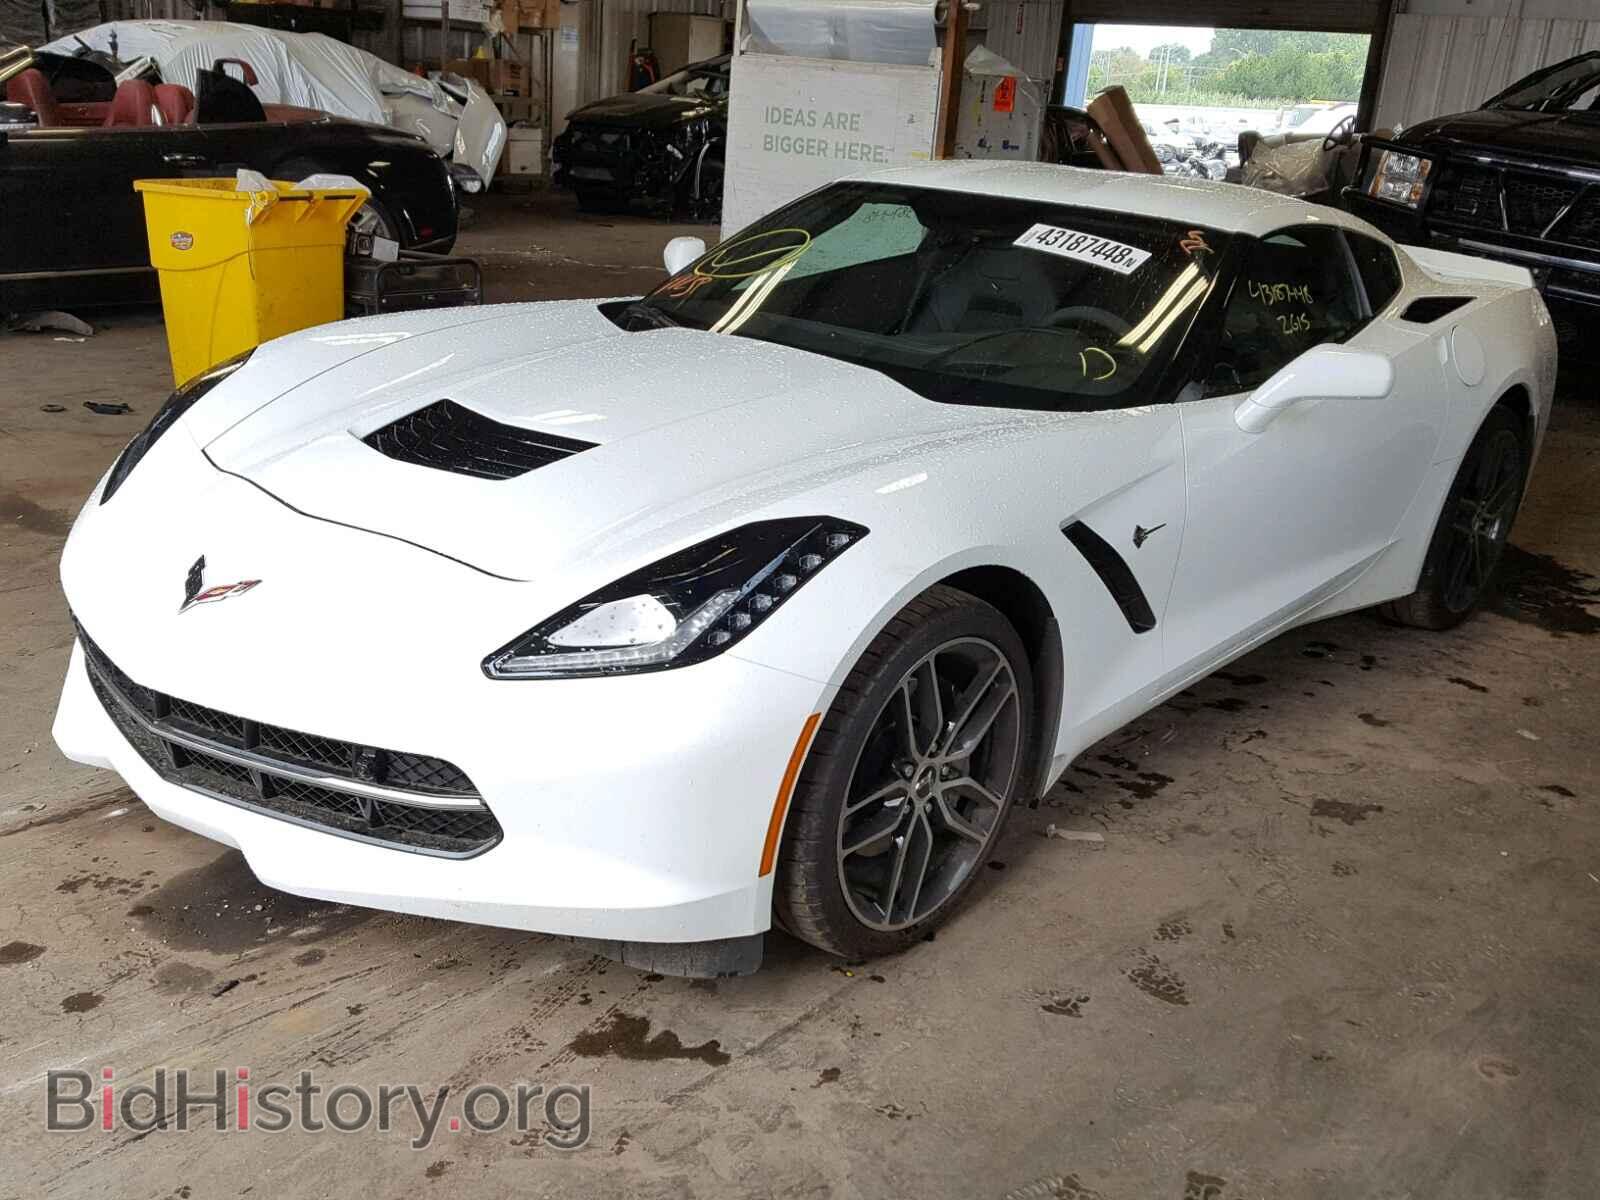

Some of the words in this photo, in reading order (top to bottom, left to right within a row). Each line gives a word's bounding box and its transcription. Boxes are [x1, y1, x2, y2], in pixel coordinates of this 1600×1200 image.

[764, 106, 817, 128] IDEAS
[822, 111, 862, 132] ARE
[763, 133, 829, 158] BIGGER
[834, 140, 889, 164] HERE.
[1036, 228, 1133, 264] 43187448
[1124, 257, 1138, 268] N
[1276, 312, 1311, 335] 2615
